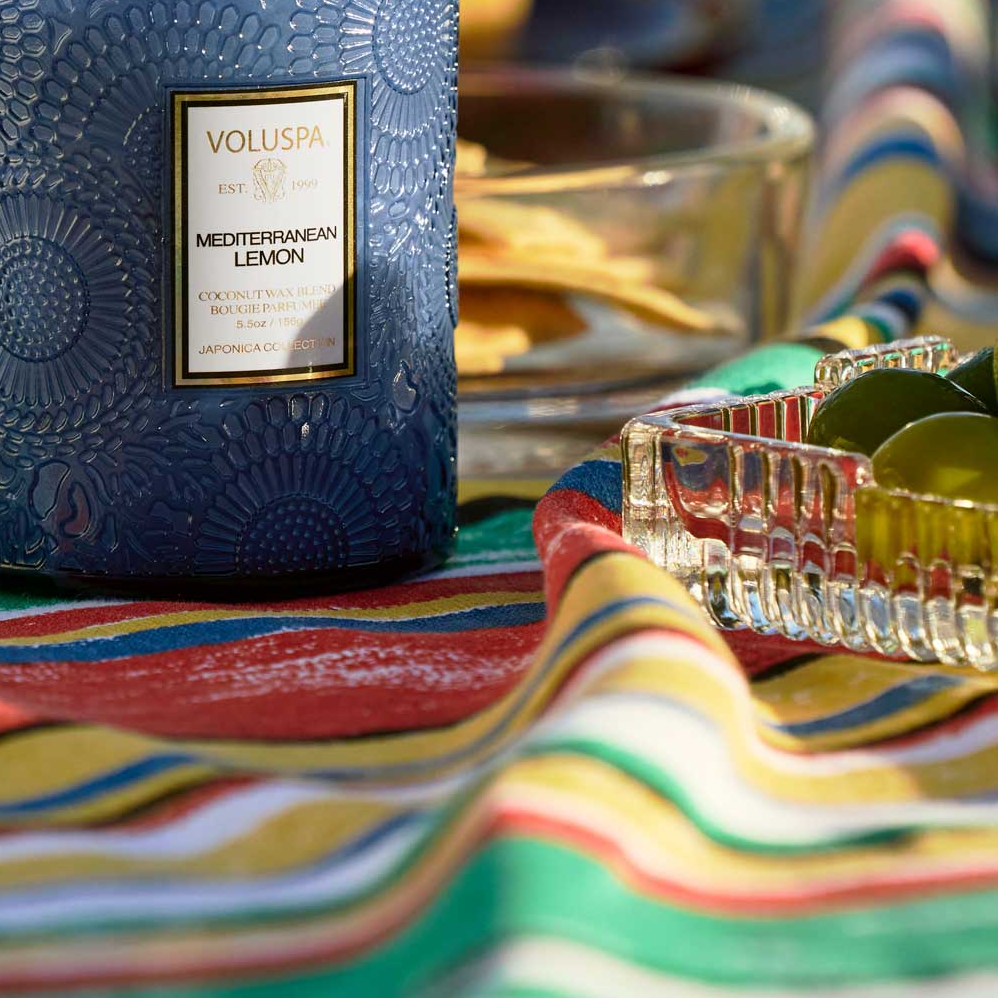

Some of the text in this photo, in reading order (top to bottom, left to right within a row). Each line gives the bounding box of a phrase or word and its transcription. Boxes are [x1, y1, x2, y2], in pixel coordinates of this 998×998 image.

[206, 125, 324, 153] VOLUSPA
[218, 183, 248, 195] EST.
[196, 226, 337, 247] MEDITERRANEAN
[234, 248, 304, 267] LEMON
[198, 289, 263, 302] COCONUT
[265, 287, 294, 300] WAX
[210, 302, 260, 315] BOUGIE
[236, 319, 266, 329] 5.5oz
[198, 342, 261, 355] JAPONICA
